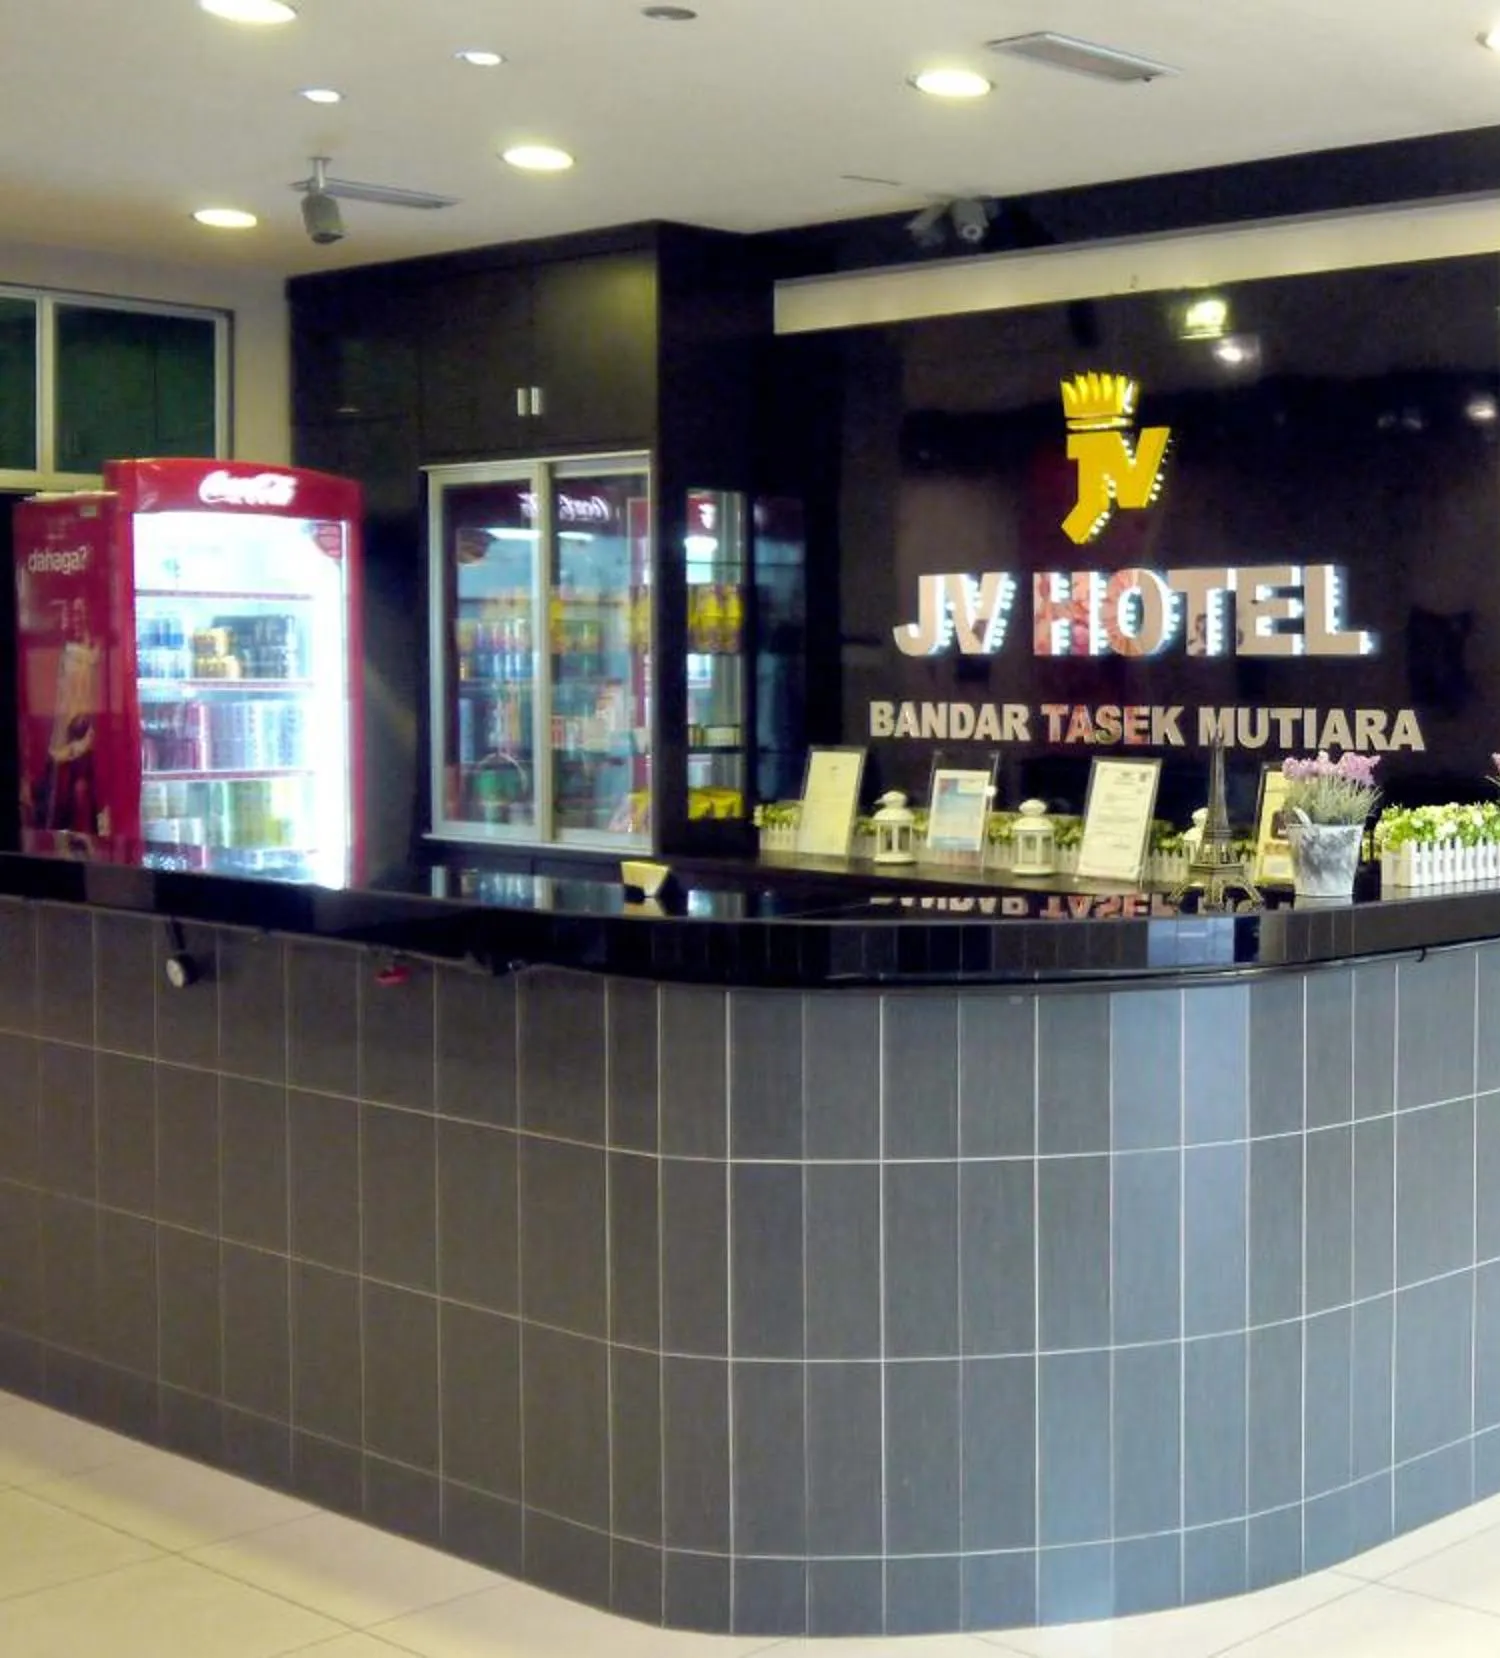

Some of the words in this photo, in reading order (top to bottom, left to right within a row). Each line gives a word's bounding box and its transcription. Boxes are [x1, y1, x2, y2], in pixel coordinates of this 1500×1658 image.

[1061, 427, 1171, 544] JV
[893, 571, 1016, 656] JV
[1032, 564, 1376, 656] HOTEL
[869, 700, 1031, 741] BANDAR
[1040, 703, 1185, 746] TASEK
[1199, 706, 1425, 751] MUTIARA
